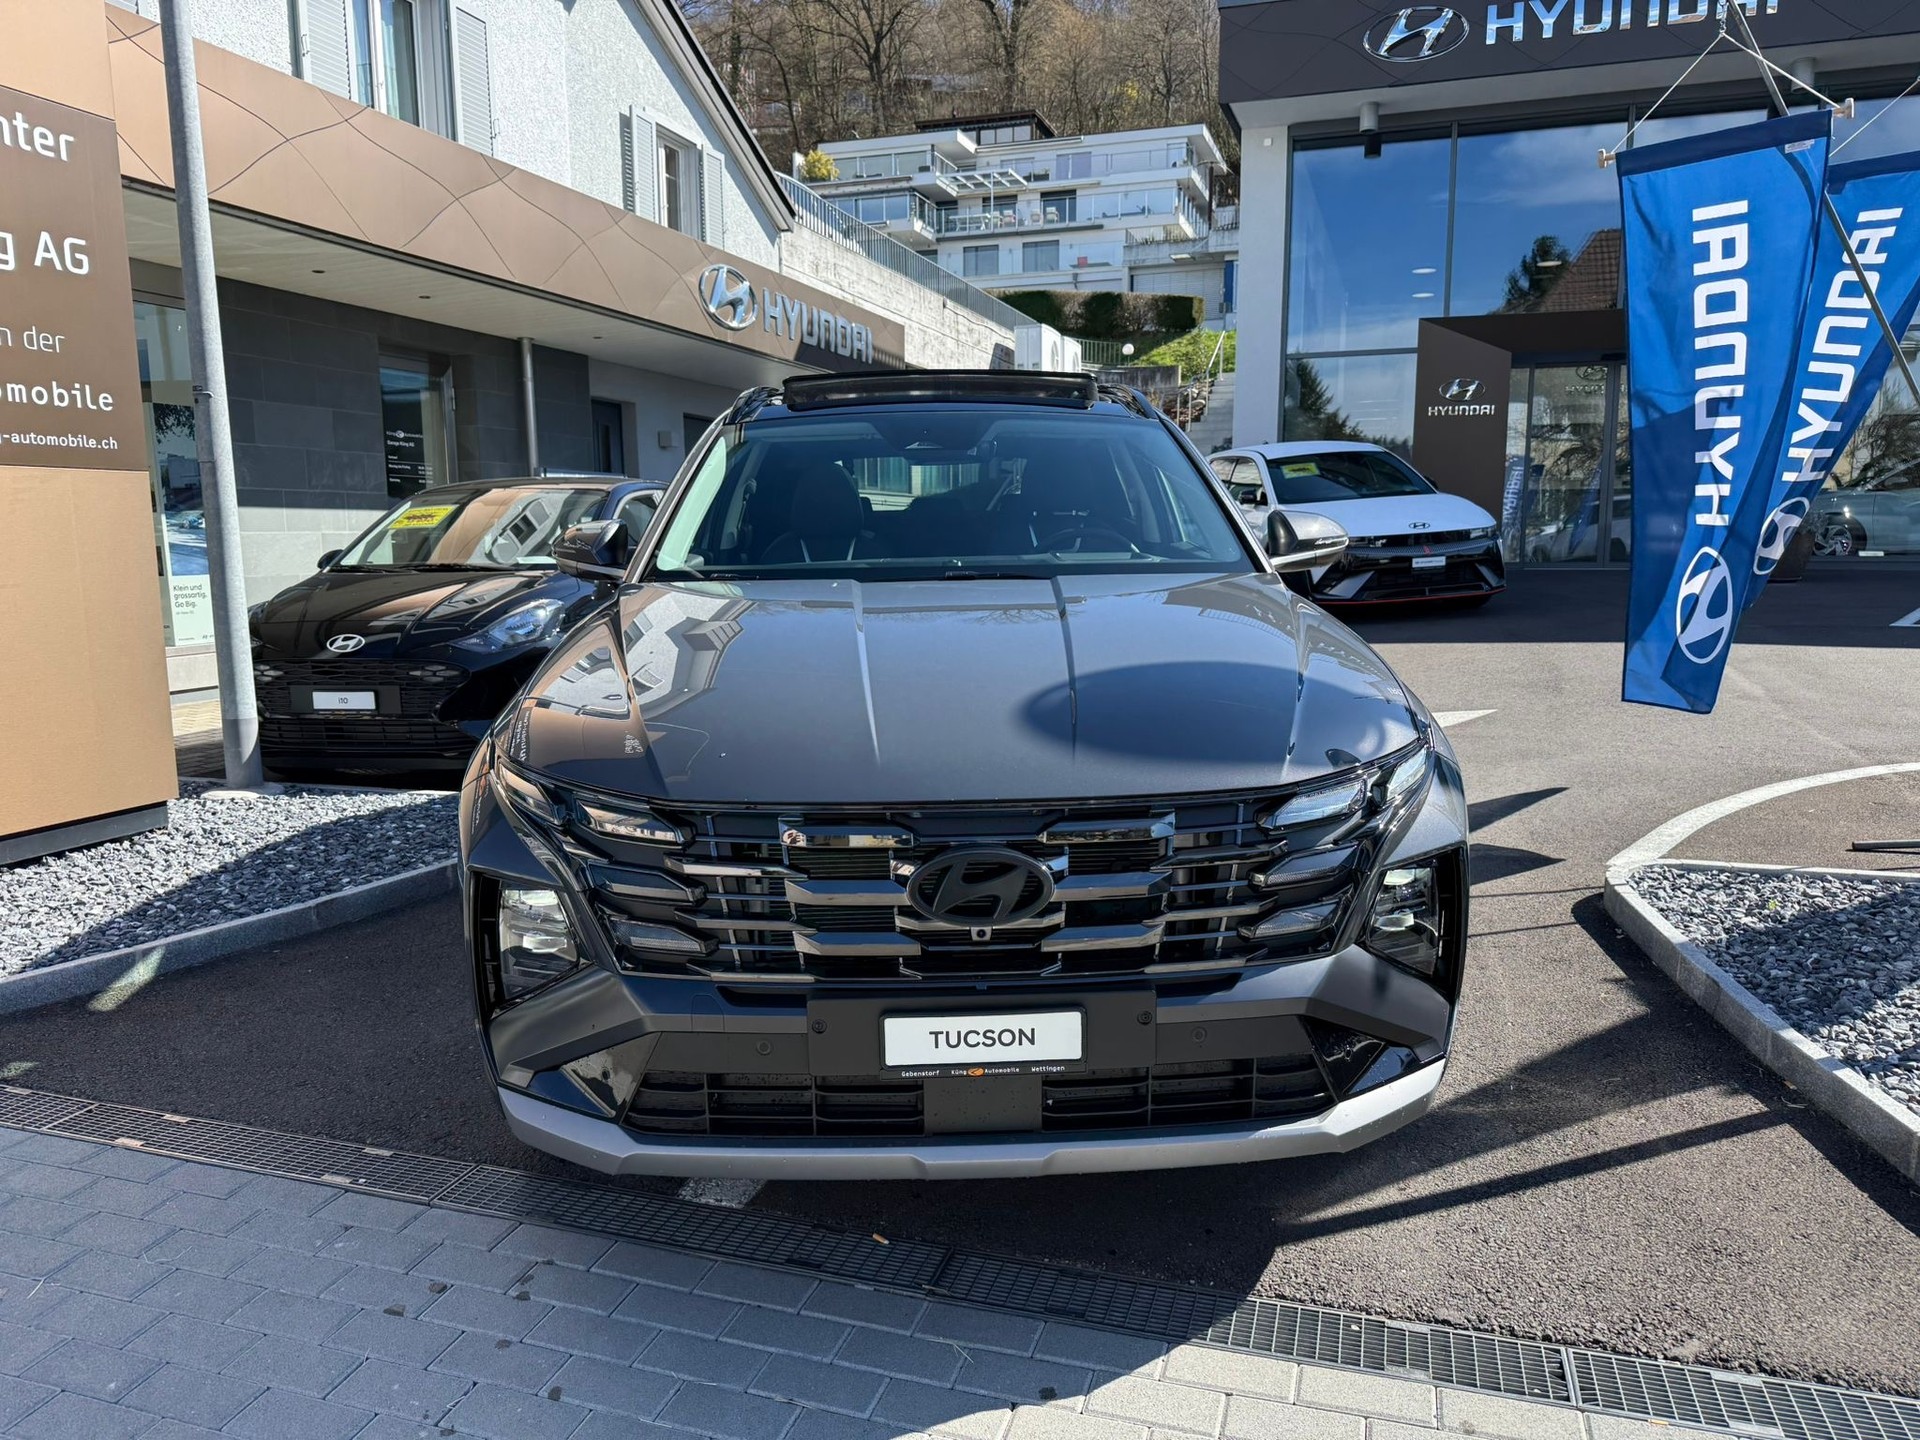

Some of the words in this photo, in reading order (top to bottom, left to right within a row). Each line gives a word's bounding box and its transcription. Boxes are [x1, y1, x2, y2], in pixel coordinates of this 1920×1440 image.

[0, 111, 75, 162] nter
[33, 231, 89, 275] AG
[23, 325, 65, 353] der
[763, 287, 873, 364] HYUNDAI
[1781, 207, 1903, 482] HYUNDAI
[0, 380, 113, 411] mobile
[1428, 404, 1495, 416] HYUNDAI
[0, 432, 118, 449] -automobile.ch
[173, 584, 189, 592] Klein
[190, 583, 202, 591] und
[929, 1028, 1036, 1049] TUCSON
[901, 1069, 940, 1077] Gebenstorf
[984, 1066, 1020, 1074] Automobile
[1031, 1065, 1065, 1073] Wettingen
